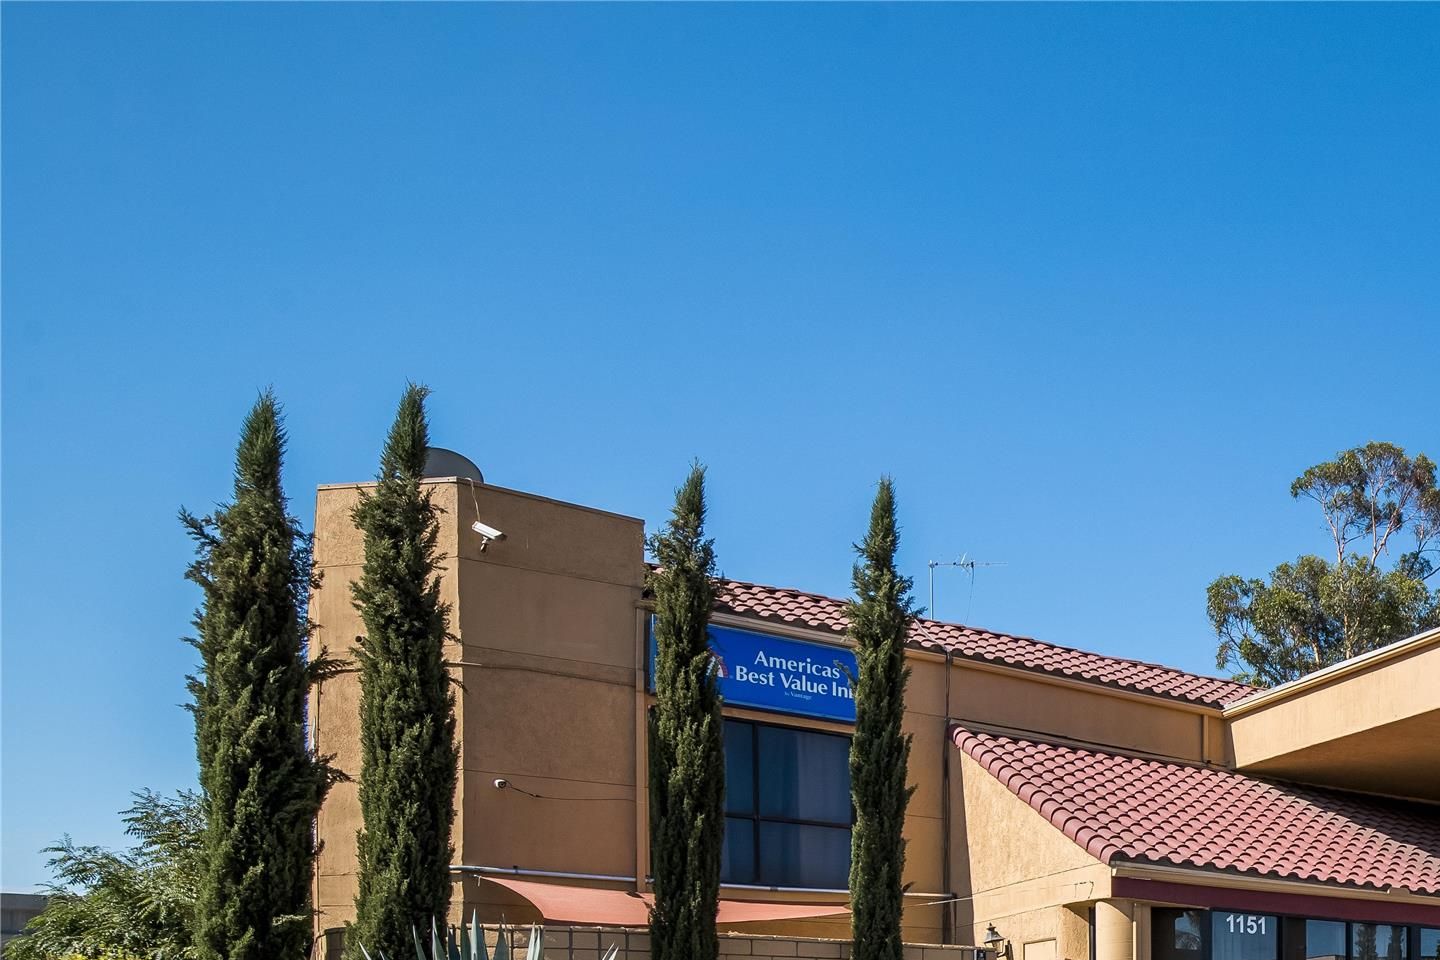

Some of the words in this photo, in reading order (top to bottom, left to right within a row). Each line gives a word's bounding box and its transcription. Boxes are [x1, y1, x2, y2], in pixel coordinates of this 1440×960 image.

[754, 650, 840, 679] Americas
[735, 665, 775, 687] Best
[780, 672, 828, 695] Value
[1226, 914, 1266, 935] 1151
